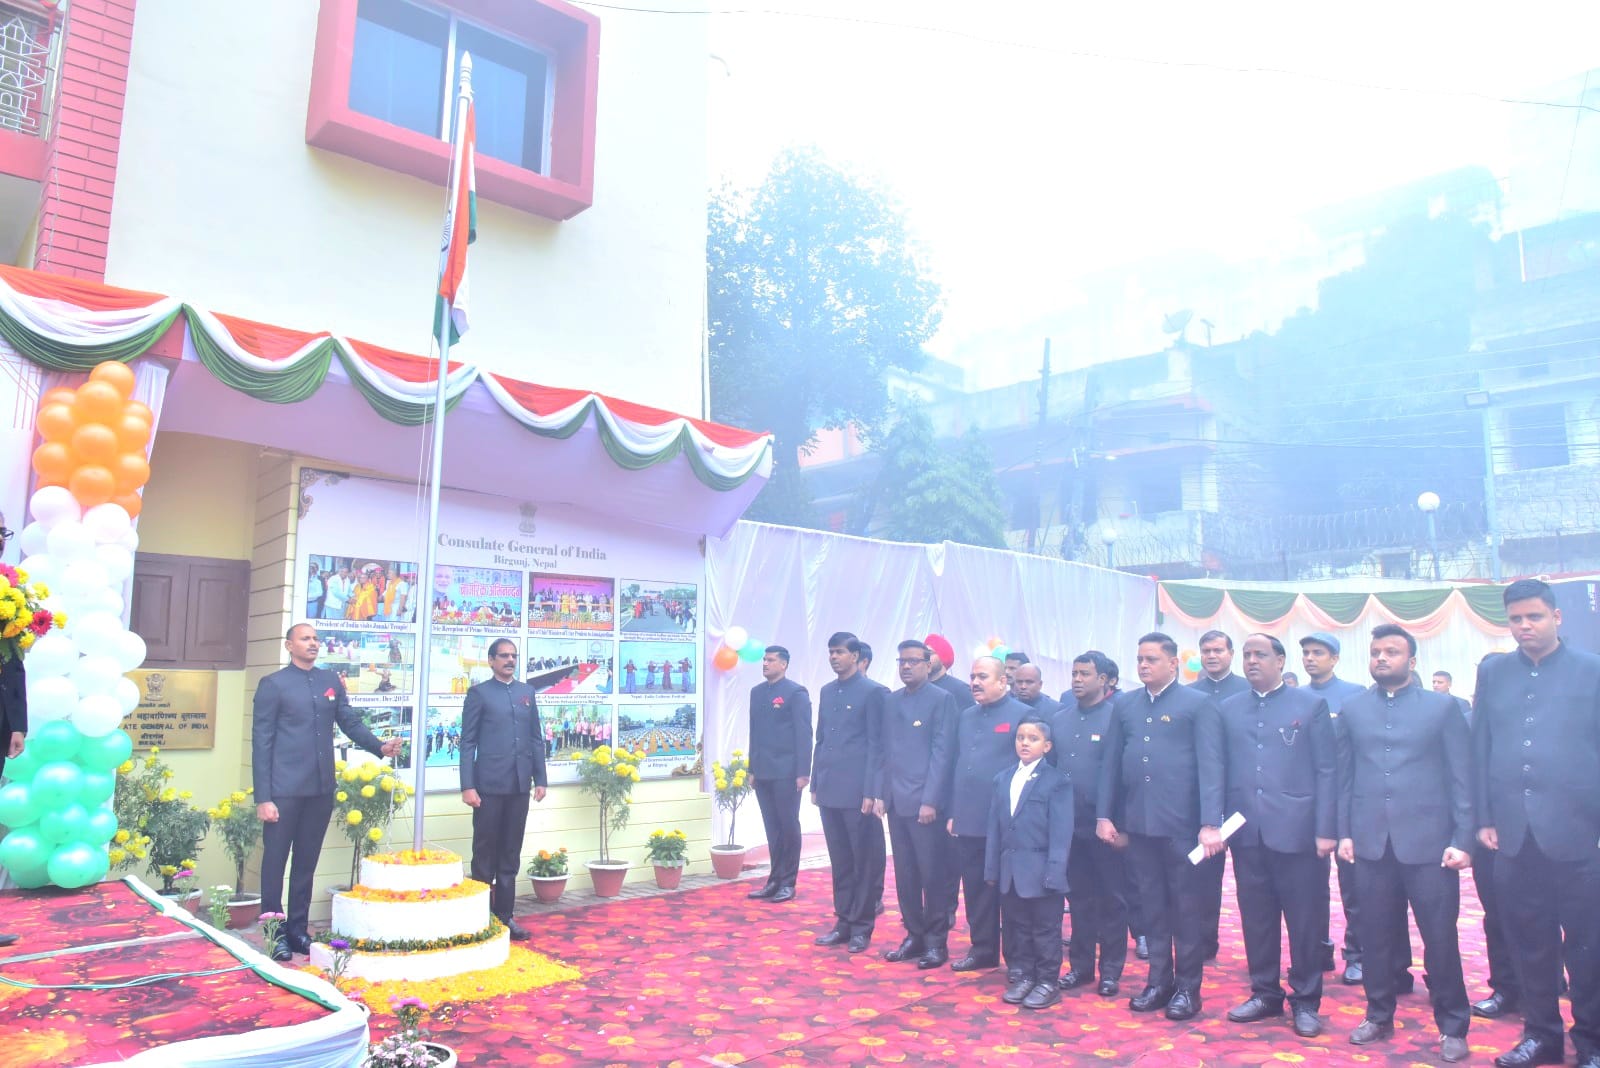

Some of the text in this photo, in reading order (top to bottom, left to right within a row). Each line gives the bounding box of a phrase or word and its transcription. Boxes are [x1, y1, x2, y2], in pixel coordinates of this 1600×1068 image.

[438, 533, 607, 560] Consulate General of India
[494, 554, 557, 570] Birgunj, Nepal
